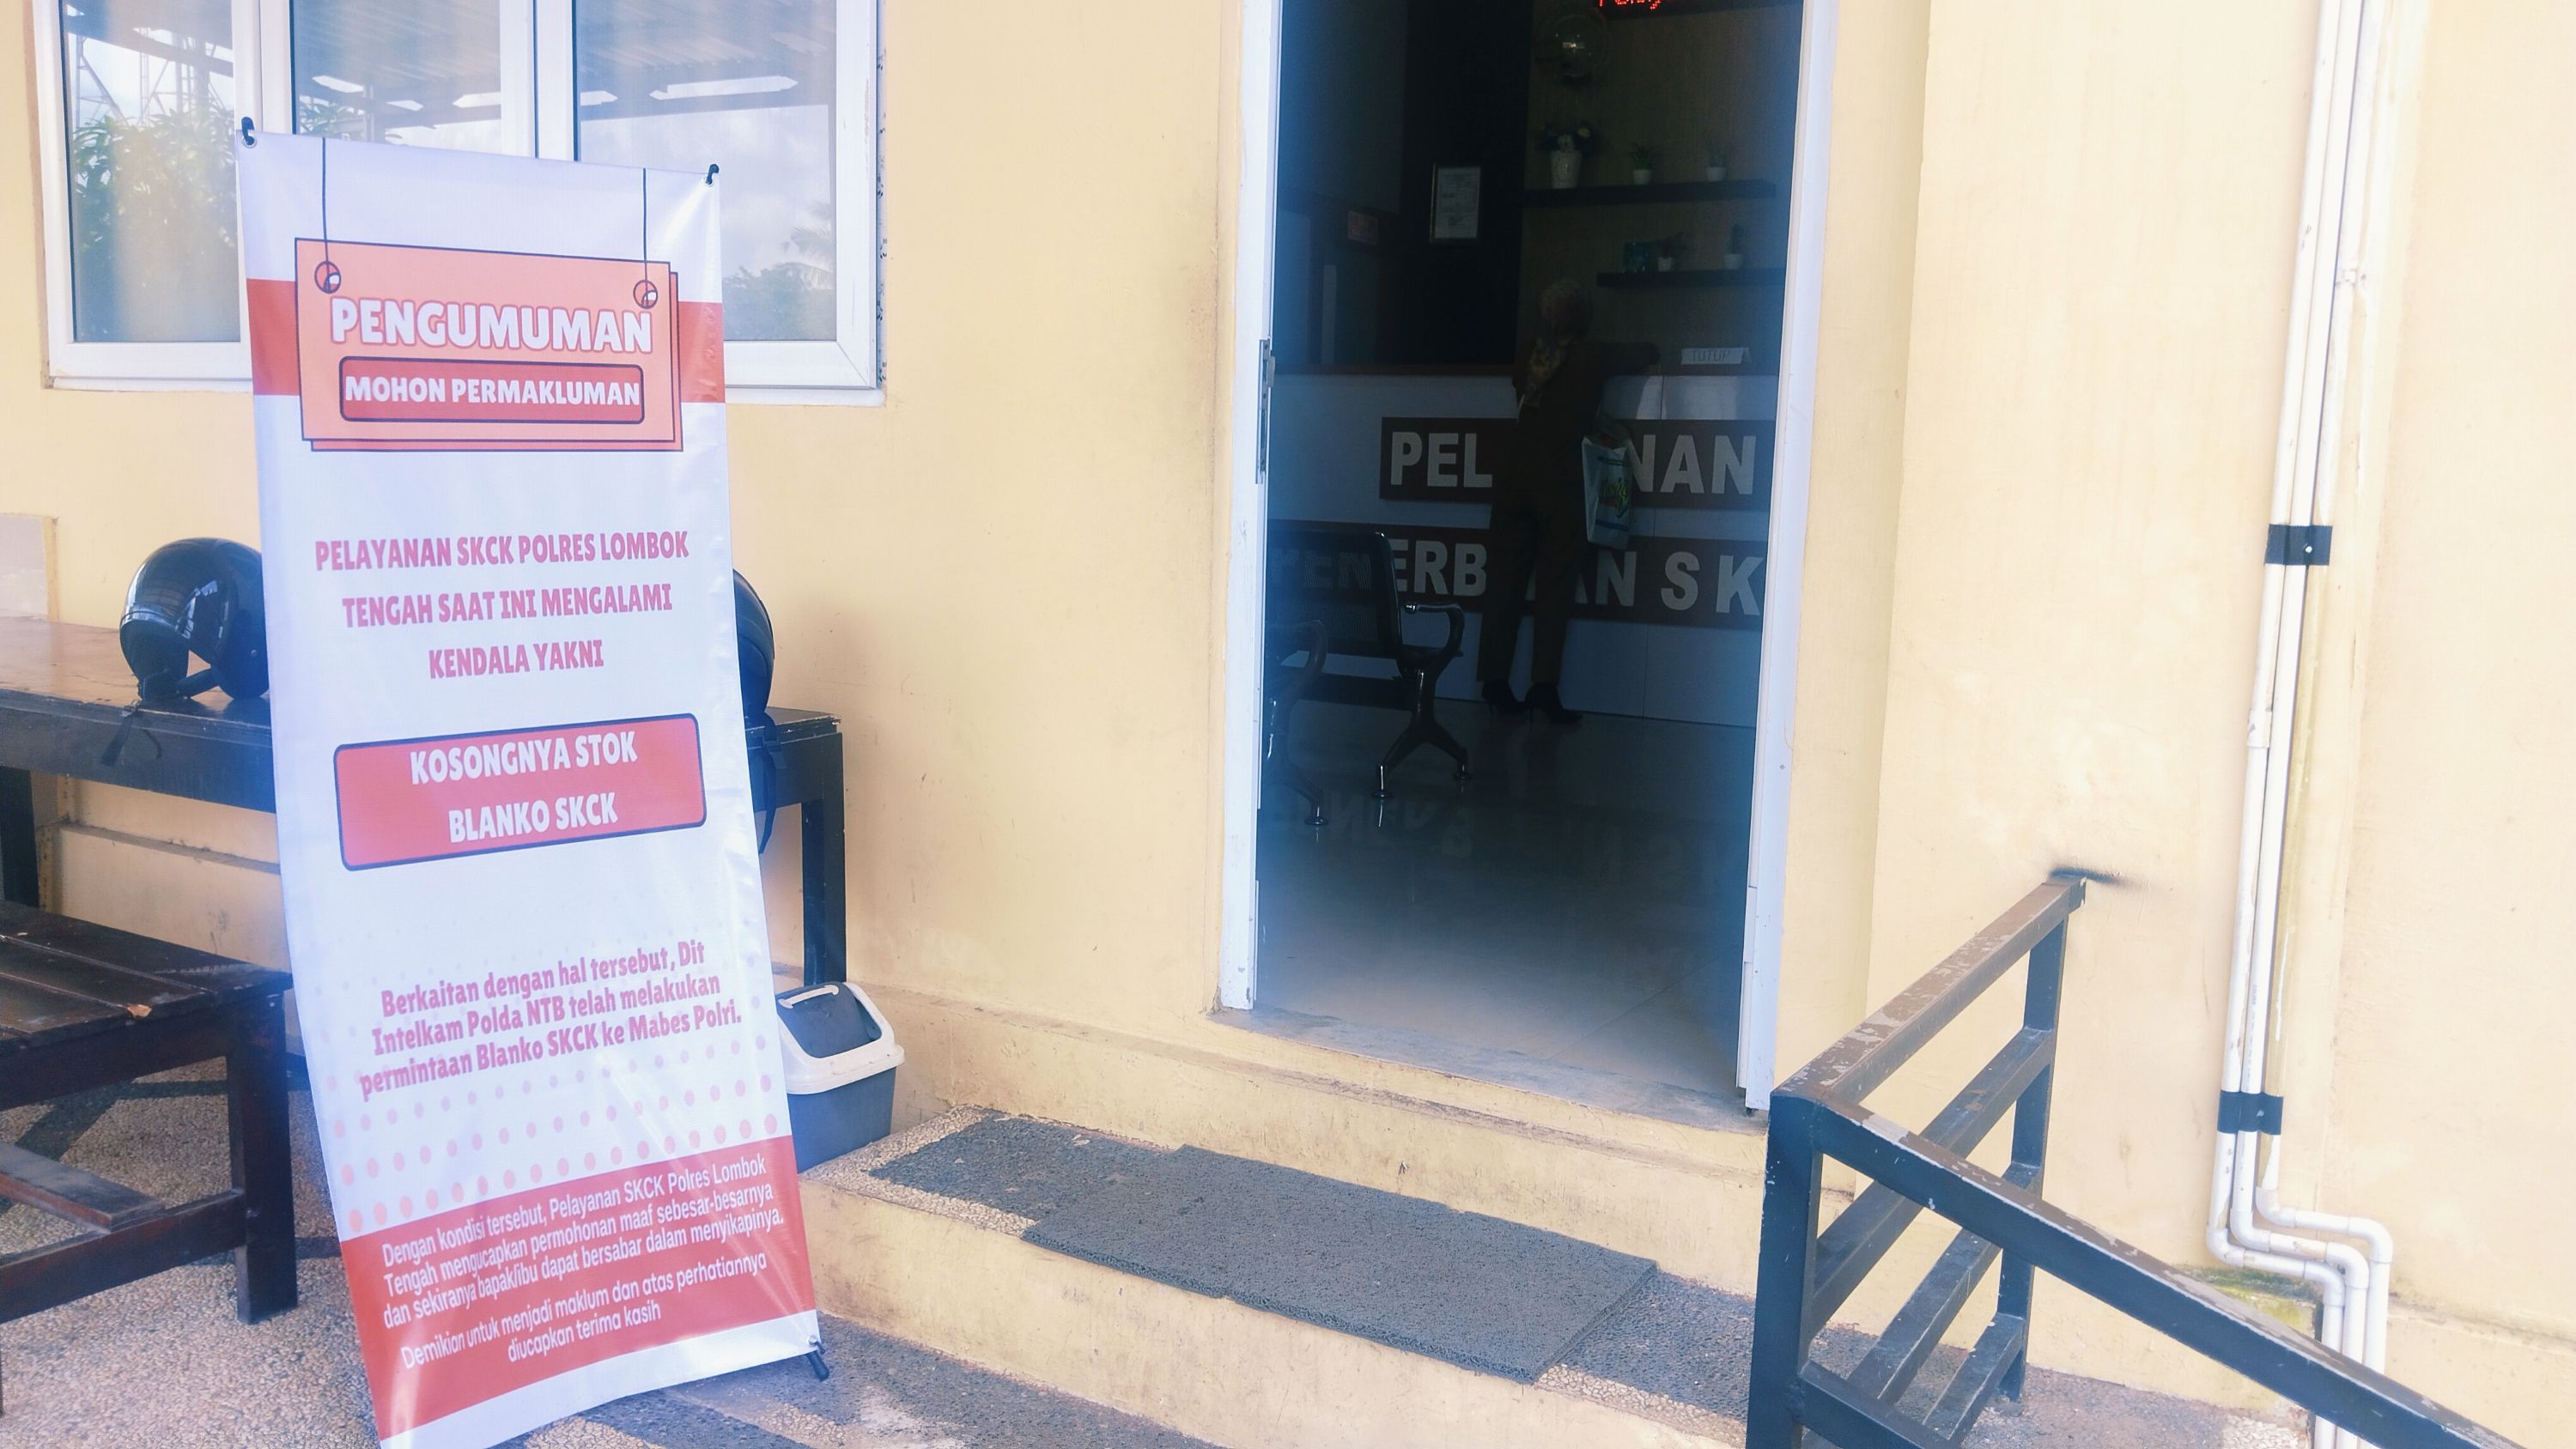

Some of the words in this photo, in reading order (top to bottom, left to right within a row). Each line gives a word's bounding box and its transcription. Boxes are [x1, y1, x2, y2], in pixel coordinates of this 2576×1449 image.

[331, 298, 653, 354] PENGUMUMAN
[345, 376, 446, 403] MOHON
[452, 378, 641, 406] PERMAKLUMAN
[1389, 432, 1757, 495] PELNAN
[315, 537, 453, 572] PELAYANAN
[457, 536, 515, 567] SKCK
[519, 533, 596, 564] POLRES
[601, 530, 690, 561] LOMBOK
[343, 594, 434, 628] TENGAH
[439, 591, 495, 622] SAAT
[500, 589, 538, 620] INI
[542, 583, 673, 617] MENGALAMI
[428, 644, 531, 679] KENDALA
[533, 639, 605, 671] YAKNI
[410, 736, 571, 785] KOSONGNYA
[575, 731, 638, 767] STOK
[449, 799, 550, 843] BLANKO
[555, 791, 619, 831] SKCK
[381, 979, 479, 1018] Berkaitan
[483, 969, 556, 1000] dengan
[558, 957, 587, 986] hal
[590, 947, 676, 981] tersebut,
[678, 938, 705, 968] Dit
[372, 1019, 464, 1056] Intelkam
[468, 1005, 523, 1037] Polda
[527, 996, 566, 1027] NTB
[569, 986, 616, 1019] telah
[620, 973, 721, 1006] melakukan
[360, 1052, 472, 1103] permintaan
[477, 1034, 544, 1072] Blanko
[547, 1022, 599, 1058] SKCK
[602, 1021, 625, 1047] ke
[628, 1004, 690, 1042] Mabes
[694, 998, 742, 1030] Polri.
[382, 1236, 437, 1268] Dengan
[437, 1216, 485, 1251] kondisi
[486, 1203, 548, 1237] tersebut,
[550, 1189, 621, 1221] Pelayanan
[623, 1174, 665, 1203] SKCK
[667, 1167, 711, 1194] Polres
[713, 1153, 767, 1185] Lombok
[384, 1262, 439, 1297] Tengah
[440, 1239, 528, 1277] mengucapkan
[531, 1216, 617, 1260] permohonan
[619, 1203, 654, 1233] maaf
[656, 1183, 774, 1224] sebesar-besarnya
[384, 1303, 411, 1329] dan
[413, 1282, 477, 1319] sekiranya
[541, 1252, 580, 1282] dapat
[582, 1237, 641, 1270] bersabar
[646, 1227, 688, 1254] dalam
[690, 1206, 784, 1244] menyikapinya.
[400, 1331, 465, 1369] Demikian
[466, 1317, 501, 1348] untuk
[501, 1298, 553, 1335] menjadi
[556, 1287, 610, 1317] maklum
[612, 1278, 640, 1304] dan
[642, 1272, 674, 1296] atas
[676, 1251, 767, 1293] perhatiannya
[507, 1319, 574, 1363] diucapkan
[576, 1311, 622, 1341] terima
[623, 1299, 661, 1327] kasih
